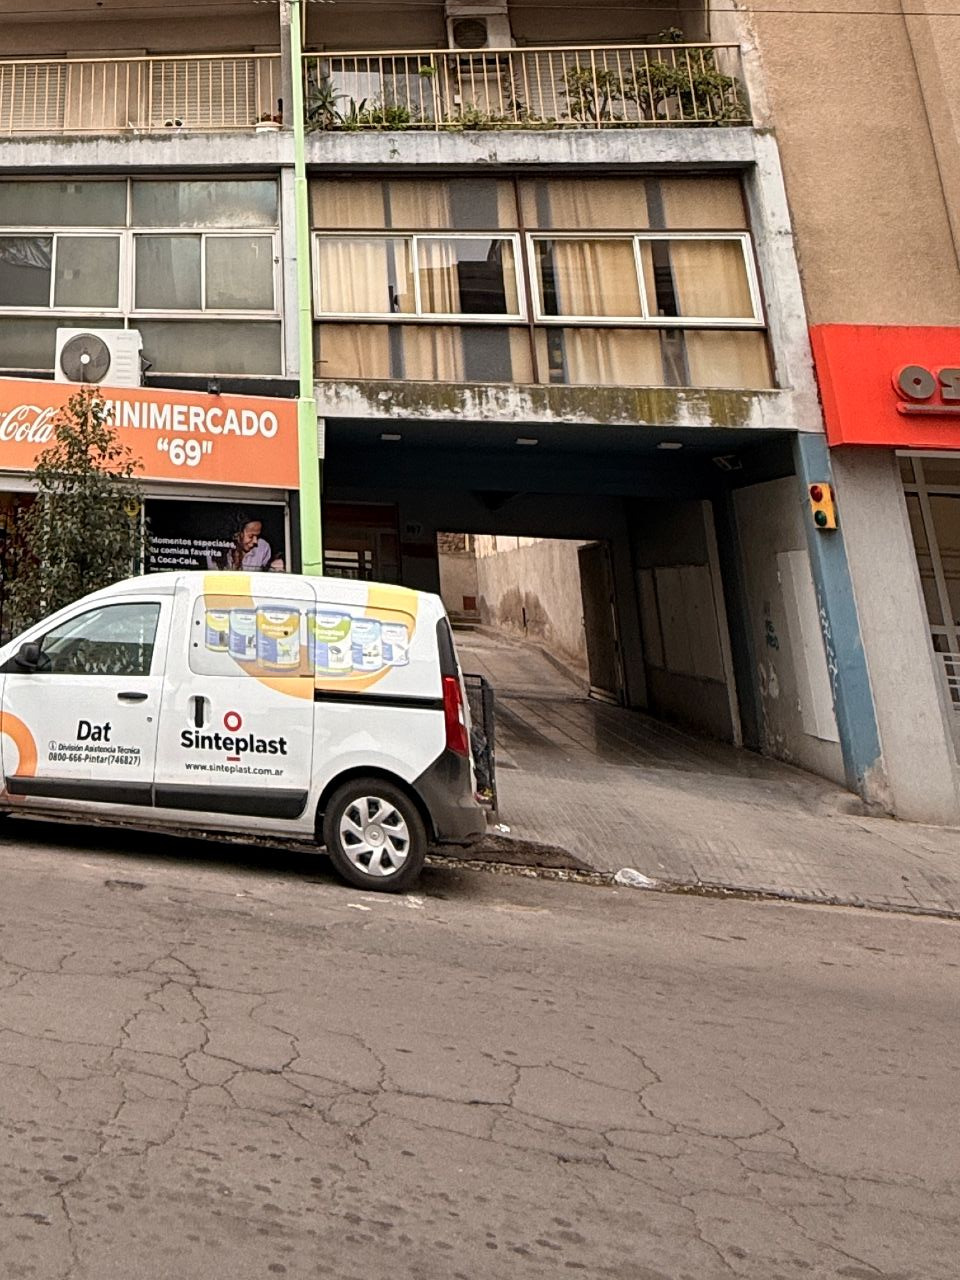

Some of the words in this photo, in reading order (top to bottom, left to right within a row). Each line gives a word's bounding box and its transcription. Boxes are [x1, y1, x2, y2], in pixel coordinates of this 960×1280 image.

[160, 547, 189, 555] comida
[190, 548, 222, 558] favorita
[77, 720, 111, 742] Dat
[84, 744, 116, 754] Asistencia
[180, 730, 287, 756] Sinteplast
[185, 762, 284, 776] www.sinteplast.com.ar
